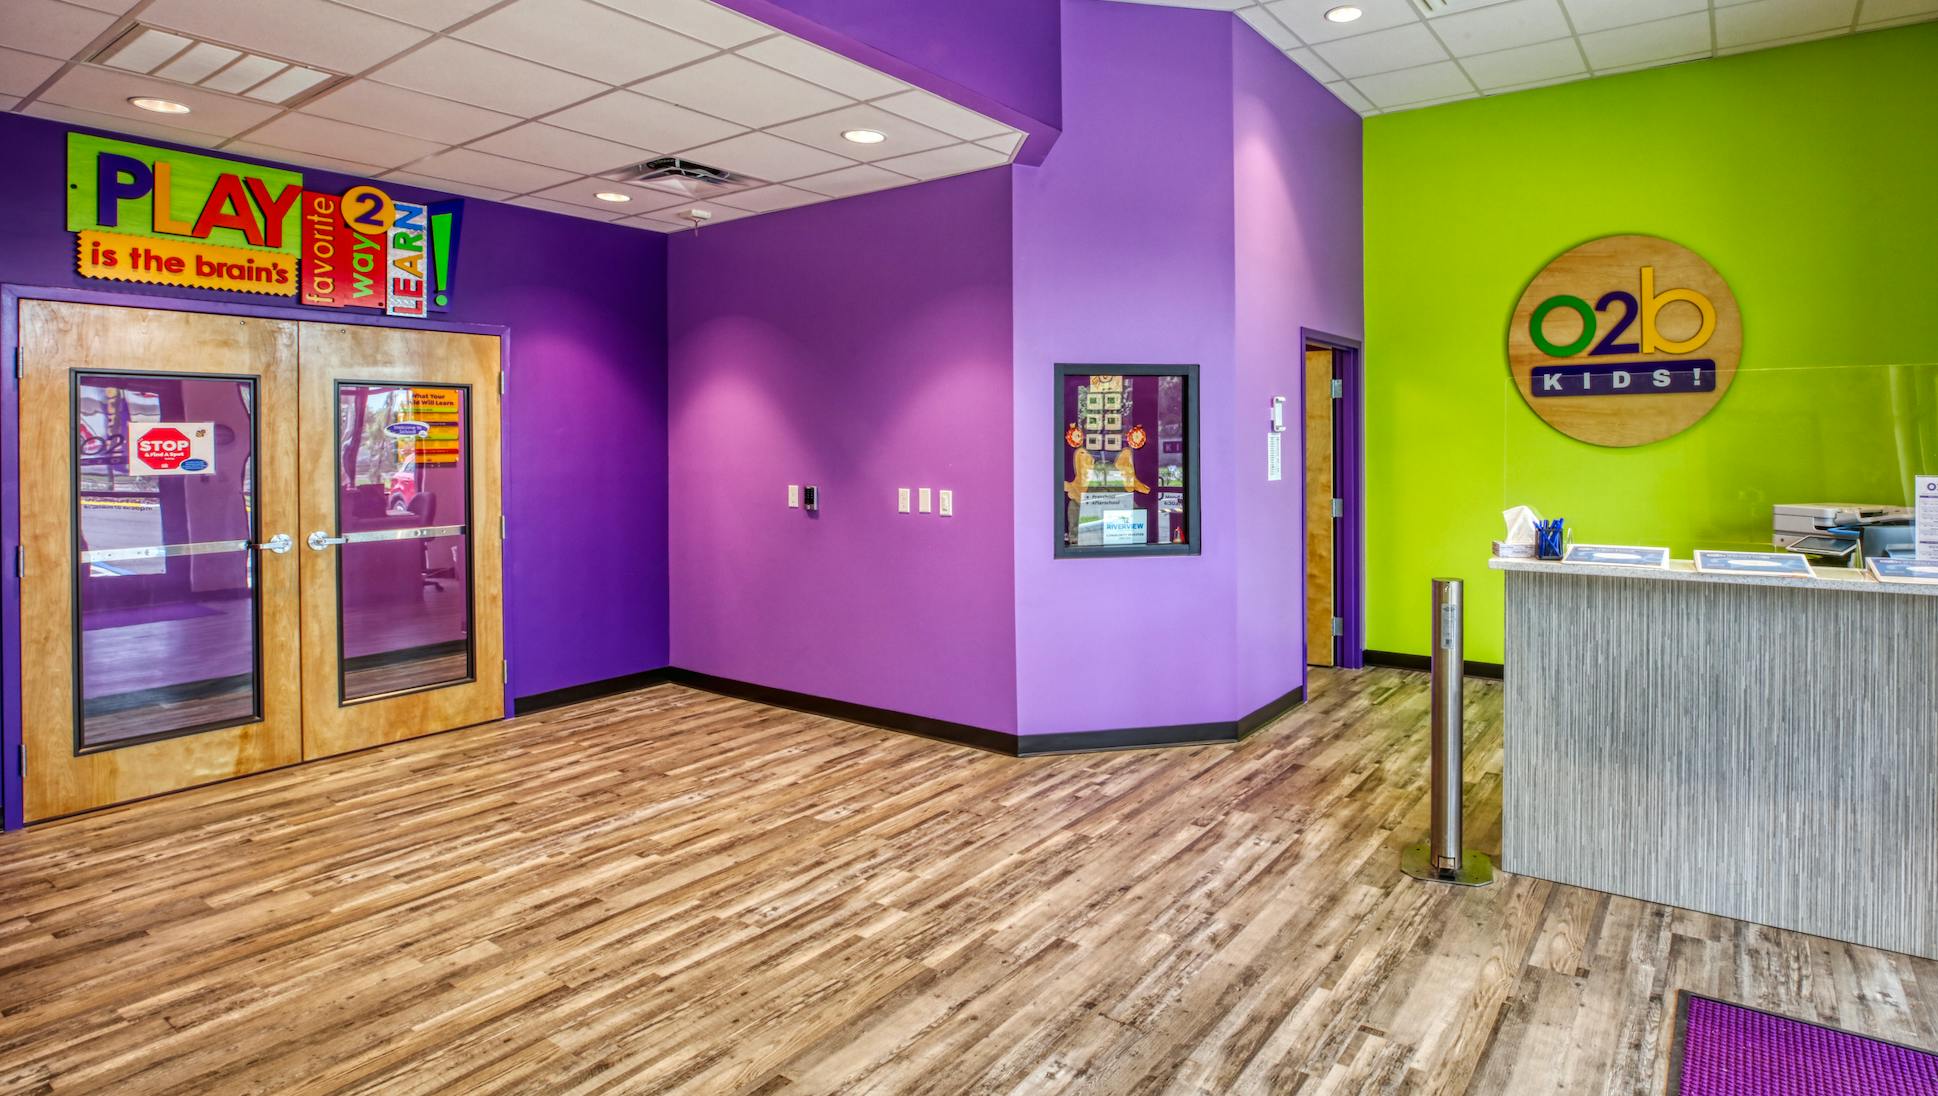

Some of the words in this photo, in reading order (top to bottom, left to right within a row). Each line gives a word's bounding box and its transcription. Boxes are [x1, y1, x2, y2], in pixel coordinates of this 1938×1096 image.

[97, 152, 303, 248] PLAY
[353, 193, 385, 227] 2
[91, 241, 118, 267] is
[130, 247, 185, 274] the
[195, 254, 289, 284] brain's
[306, 196, 336, 304] favorite
[352, 233, 382, 298] way
[393, 203, 424, 314] LEARN
[1529, 265, 1718, 358] o2b
[1543, 367, 1702, 391] KIDS!
[140, 440, 189, 452] STOP
